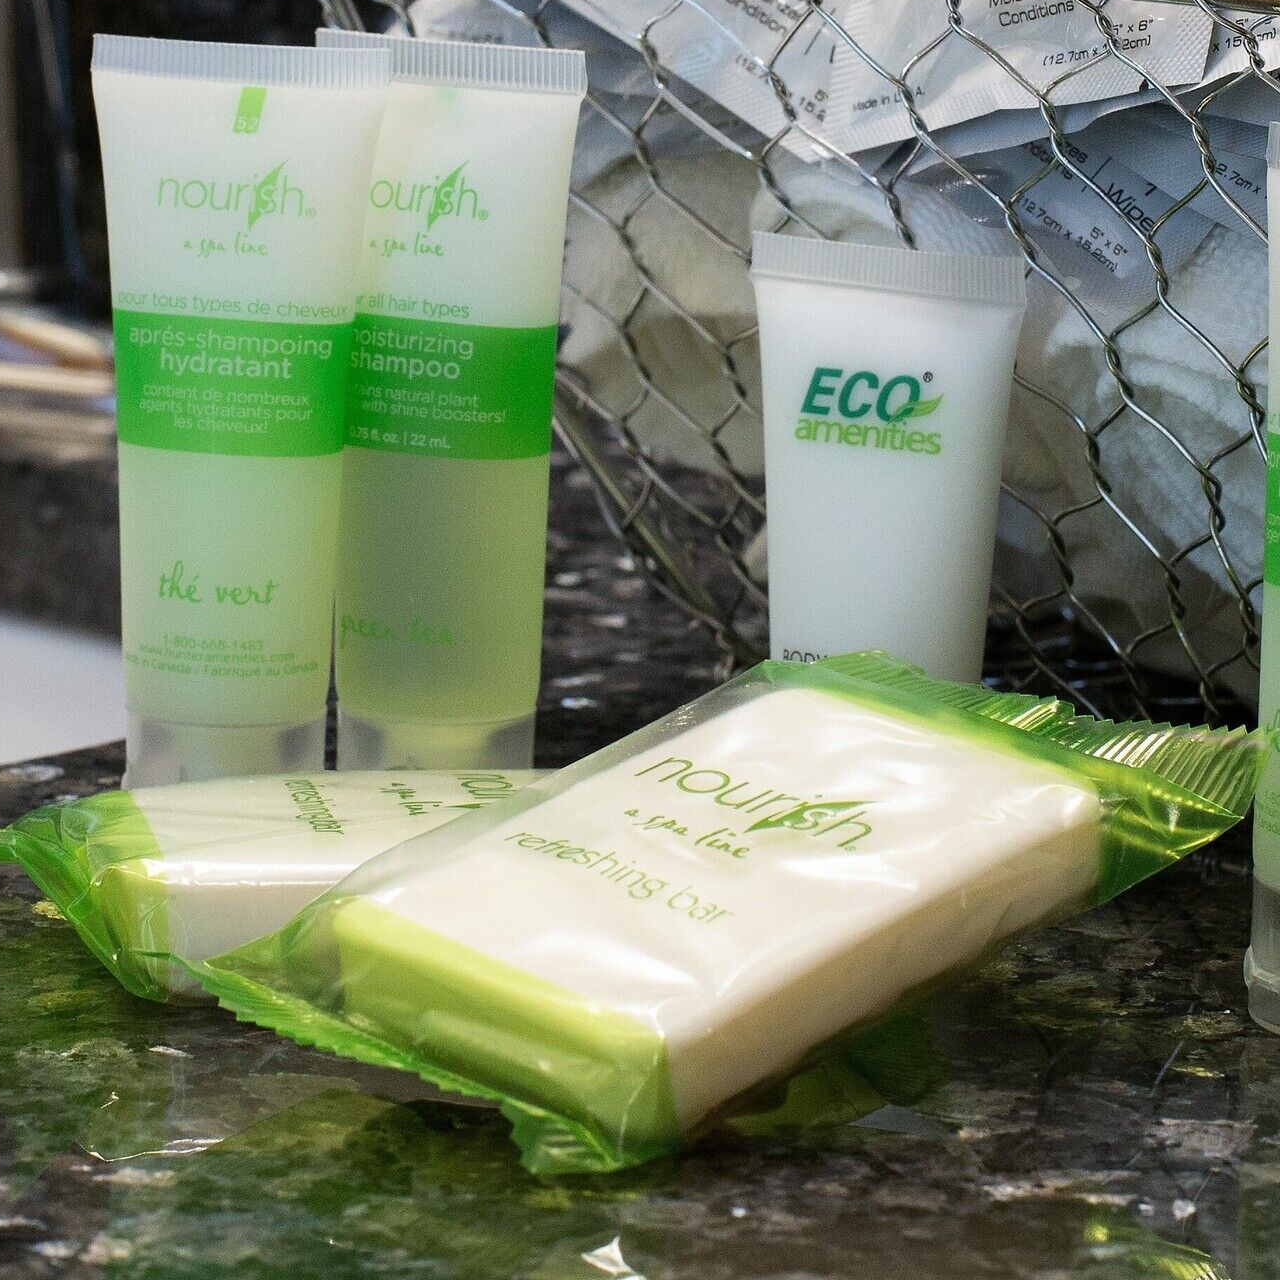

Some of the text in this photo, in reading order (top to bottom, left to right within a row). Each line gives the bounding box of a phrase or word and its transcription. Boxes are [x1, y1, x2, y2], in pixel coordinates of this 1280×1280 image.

[998, 0, 1075, 27] Conditions
[1043, 48, 1090, 66] (12.7cm
[157, 168, 304, 223] nourish
[152, 291, 187, 310] tous
[192, 294, 242, 315] types
[246, 297, 271, 316] de
[276, 300, 348, 320] cheveux
[368, 292, 385, 308] all
[388, 294, 419, 312] hair
[422, 298, 472, 319] types
[159, 347, 293, 380] hydratant
[350, 347, 461, 380] shampoo
[227, 391, 310, 408] nombreux
[438, 393, 480, 410] plant
[275, 410, 313, 427] pour
[794, 417, 942, 456] amenities
[158, 559, 279, 606] thé vert
[634, 756, 872, 848] nourish
[632, 814, 689, 837] spa
[694, 827, 753, 859] line
[505, 829, 736, 925] refreshing bar
